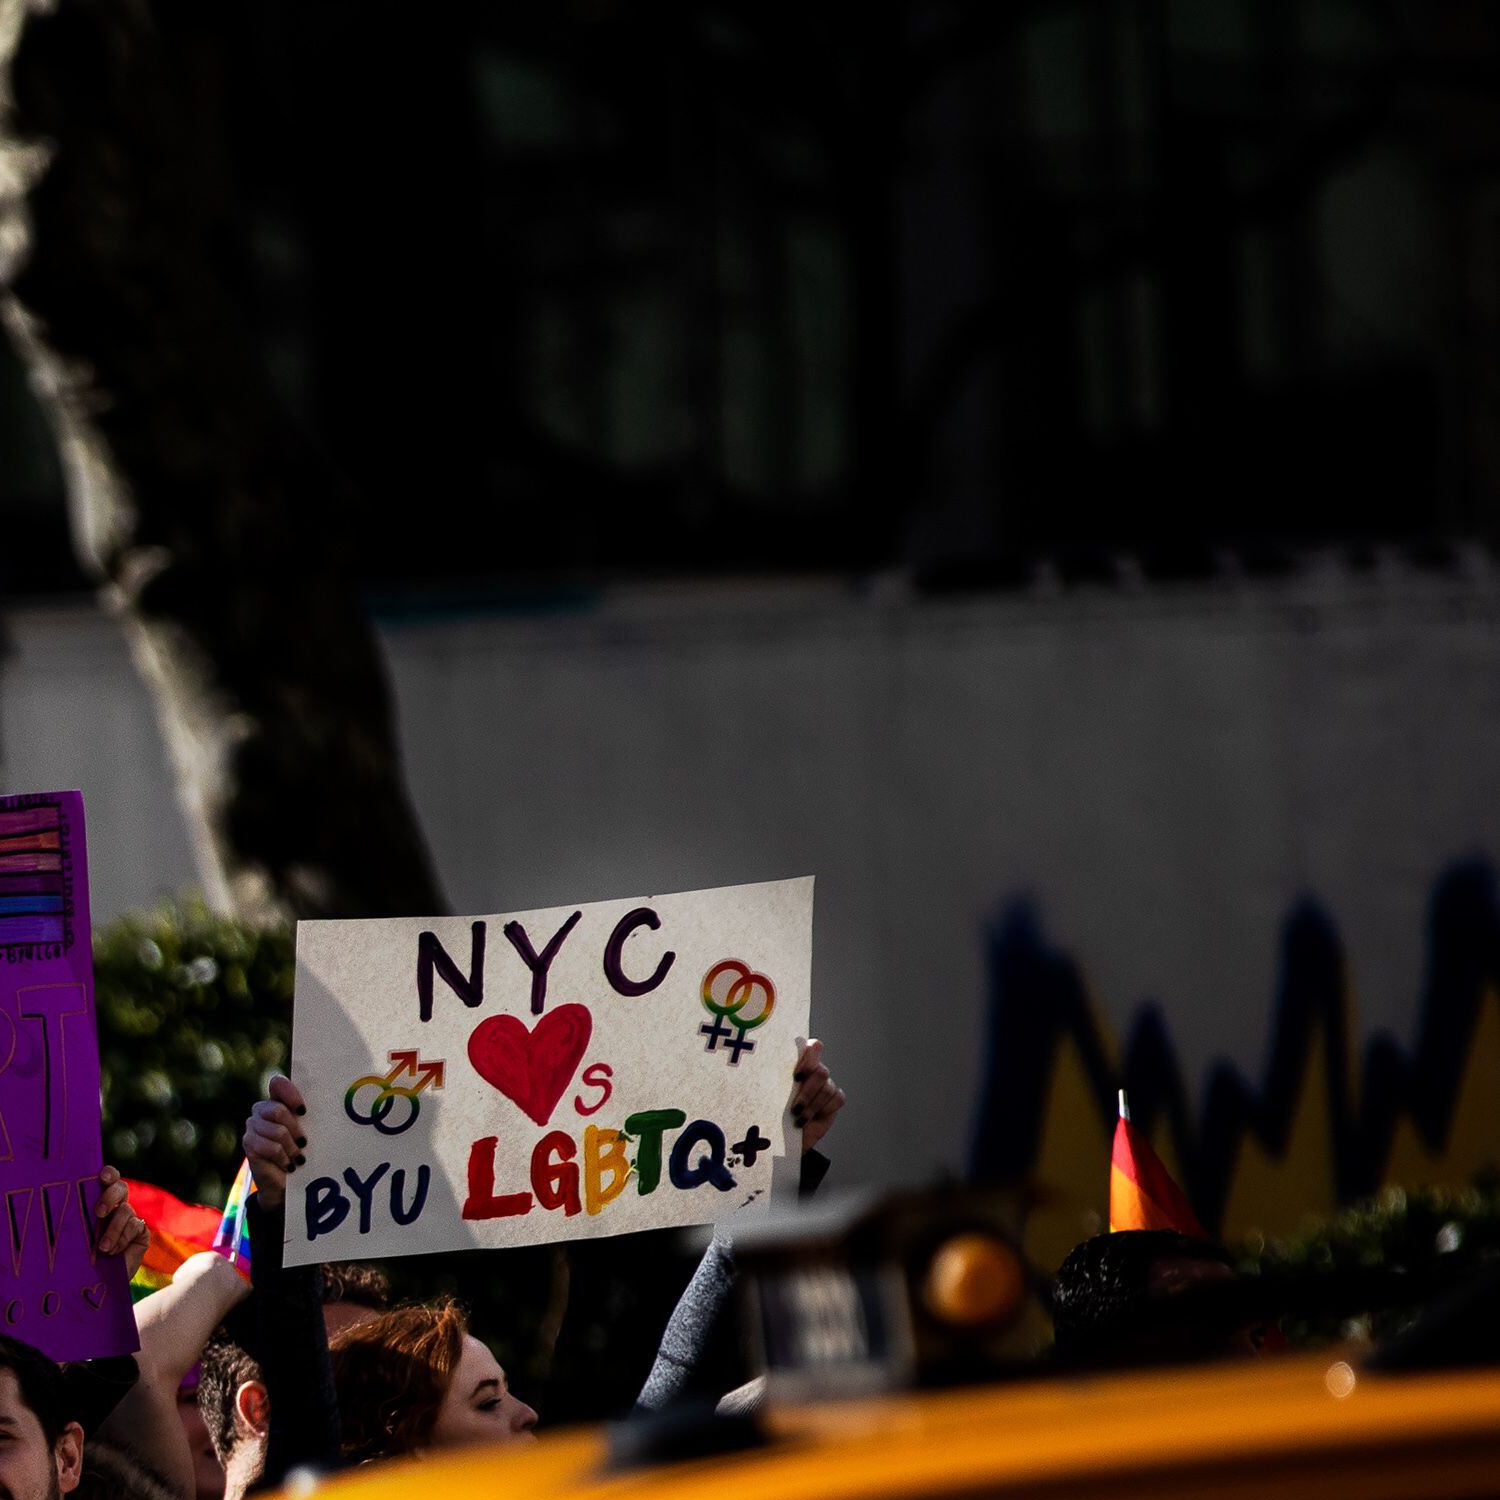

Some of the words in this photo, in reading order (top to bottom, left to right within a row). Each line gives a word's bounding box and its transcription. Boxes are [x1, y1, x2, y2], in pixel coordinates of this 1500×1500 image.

[418, 908, 676, 1022] NYC
[304, 1162, 430, 1240] BYU
[462, 1108, 771, 1221] LGBTQ+
